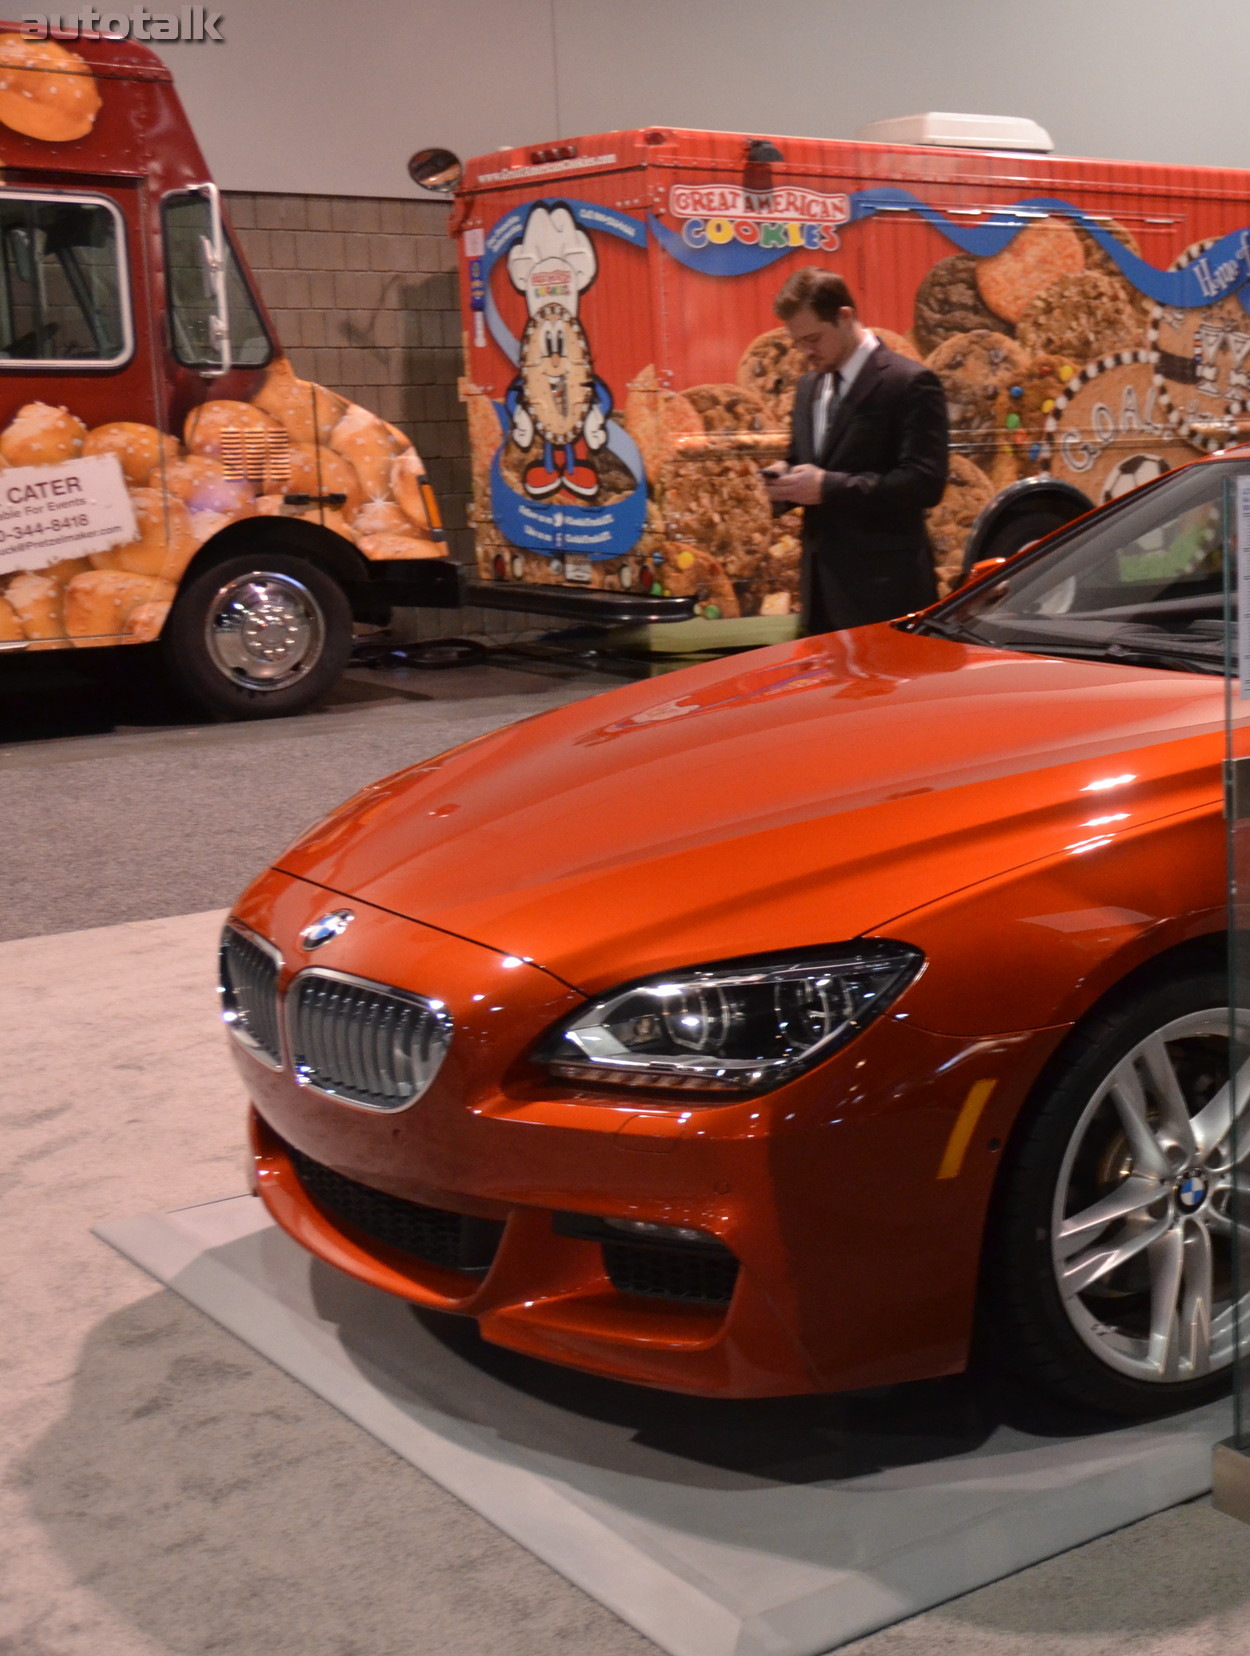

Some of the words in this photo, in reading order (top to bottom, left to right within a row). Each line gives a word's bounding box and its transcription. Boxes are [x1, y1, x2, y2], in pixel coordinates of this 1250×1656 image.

[675, 190, 741, 214] GREAT
[743, 192, 847, 220] AMERICAN
[682, 217, 841, 252] COOKIES
[1193, 257, 1240, 297] Home
[7, 476, 82, 504] CATER
[25, 505, 44, 516] For
[47, 498, 87, 512] Events
